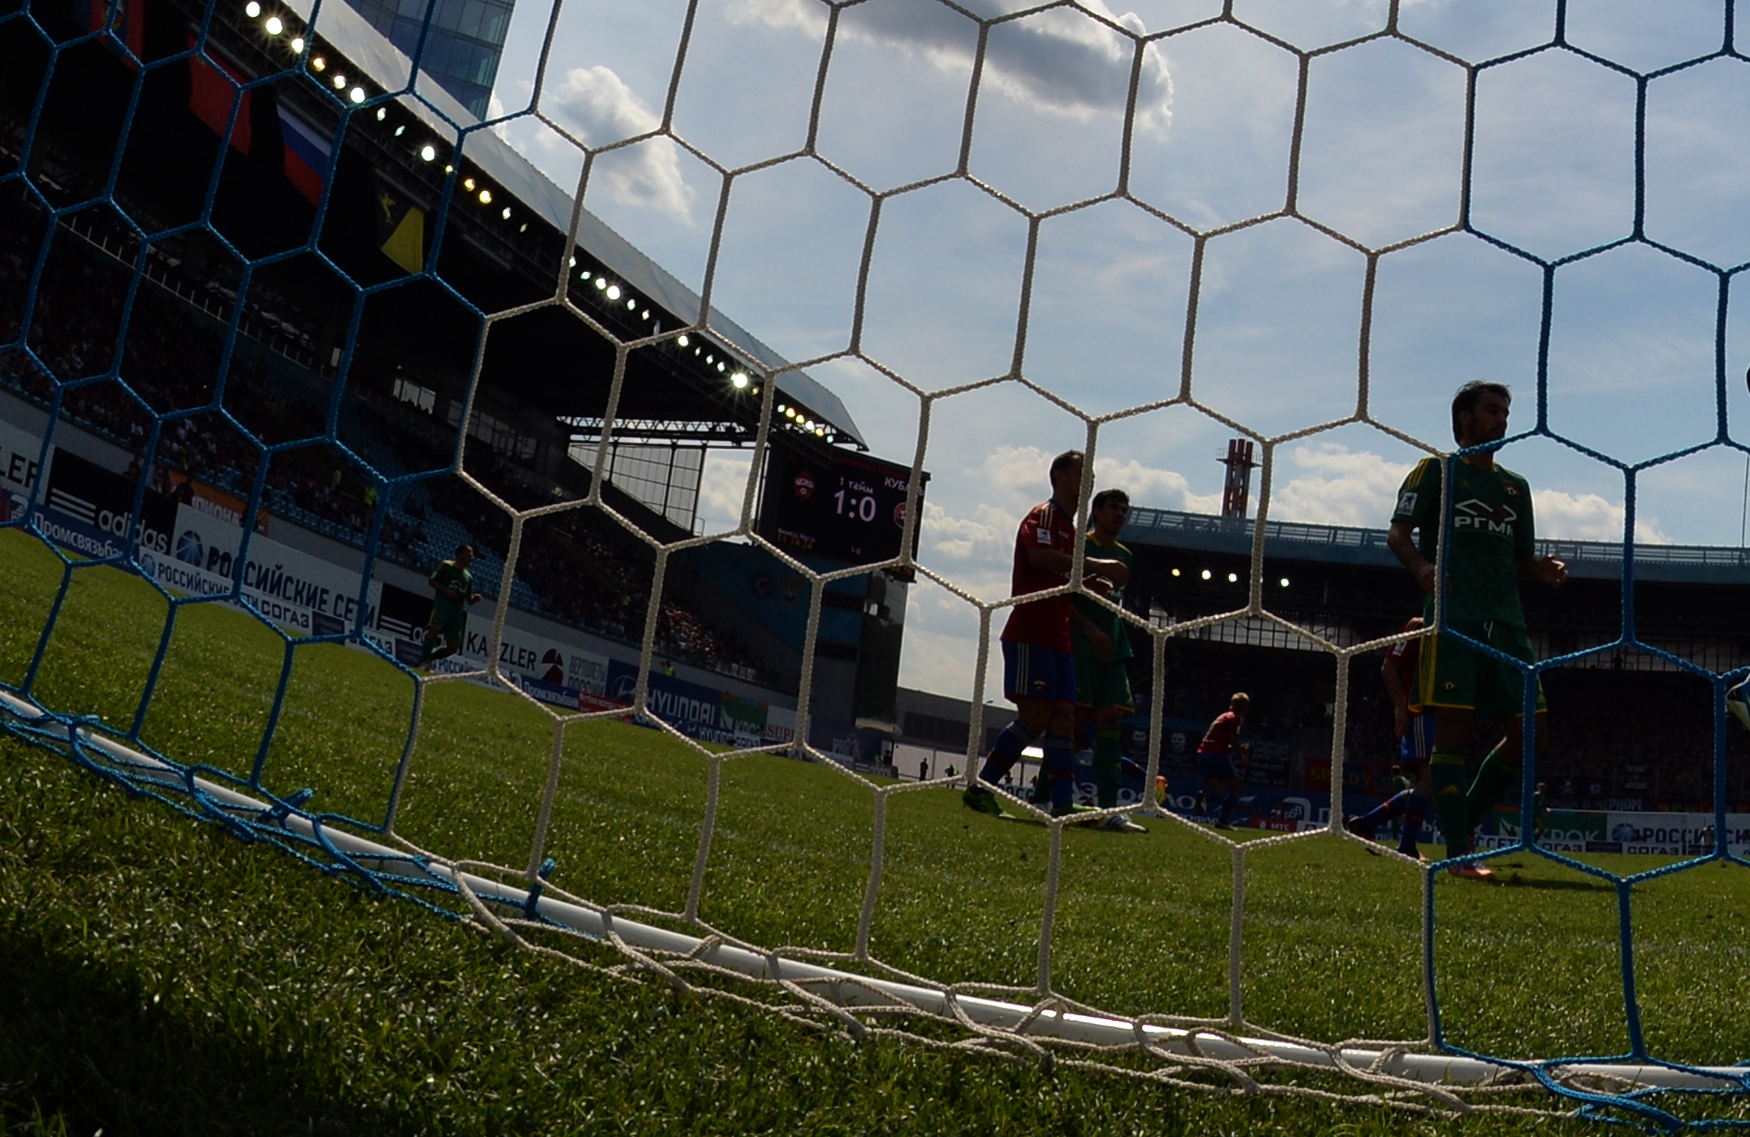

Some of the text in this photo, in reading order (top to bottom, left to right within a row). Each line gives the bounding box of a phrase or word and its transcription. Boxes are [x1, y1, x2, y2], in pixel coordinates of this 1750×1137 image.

[848, 479, 874, 495] тайм
[833, 489, 877, 523] 1:0
[98, 509, 168, 555] adidas
[261, 600, 309, 629] СОГАЗ
[466, 631, 537, 671] KAZLER
[645, 686, 716, 726] HYUNDAI
[1627, 846, 1679, 855] СОГАЗ
